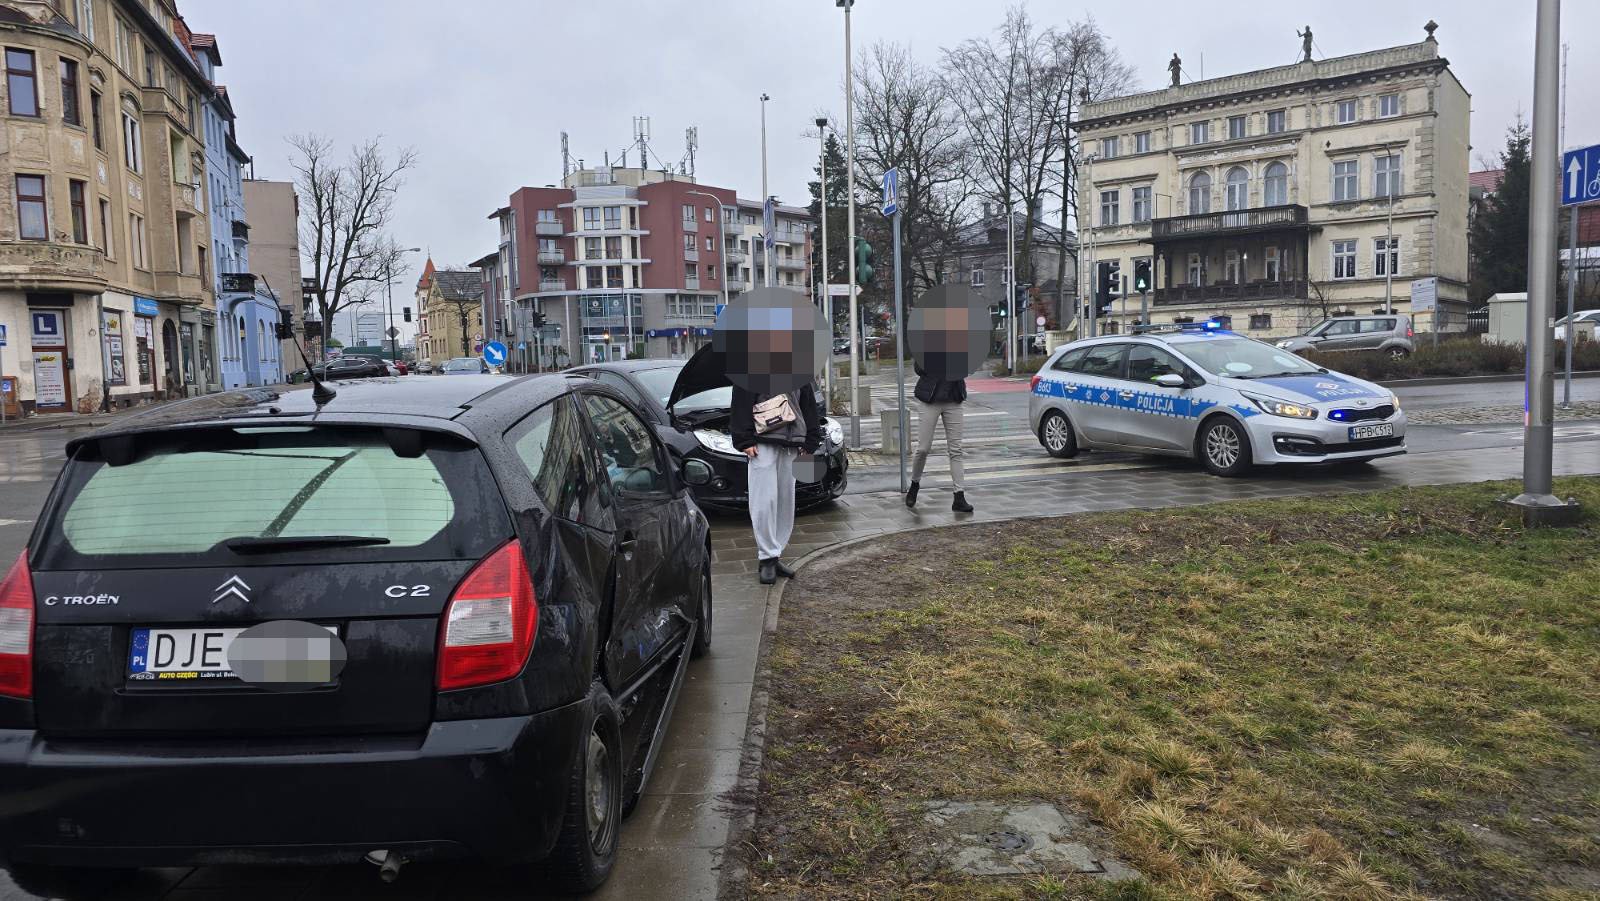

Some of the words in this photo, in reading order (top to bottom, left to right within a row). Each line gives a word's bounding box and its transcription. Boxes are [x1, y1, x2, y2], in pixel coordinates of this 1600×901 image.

[38, 316, 52, 332] L
[1137, 395, 1174, 412] POLICJA
[1355, 426, 1373, 439] HPB
[1374, 424, 1392, 436] C512
[384, 584, 430, 598] C2
[45, 593, 120, 606] CTROËN
[154, 632, 224, 668] DJE
[132, 656, 145, 666] PL
[159, 671, 175, 679] AUTO
[176, 671, 198, 680] CZĘŚCI
